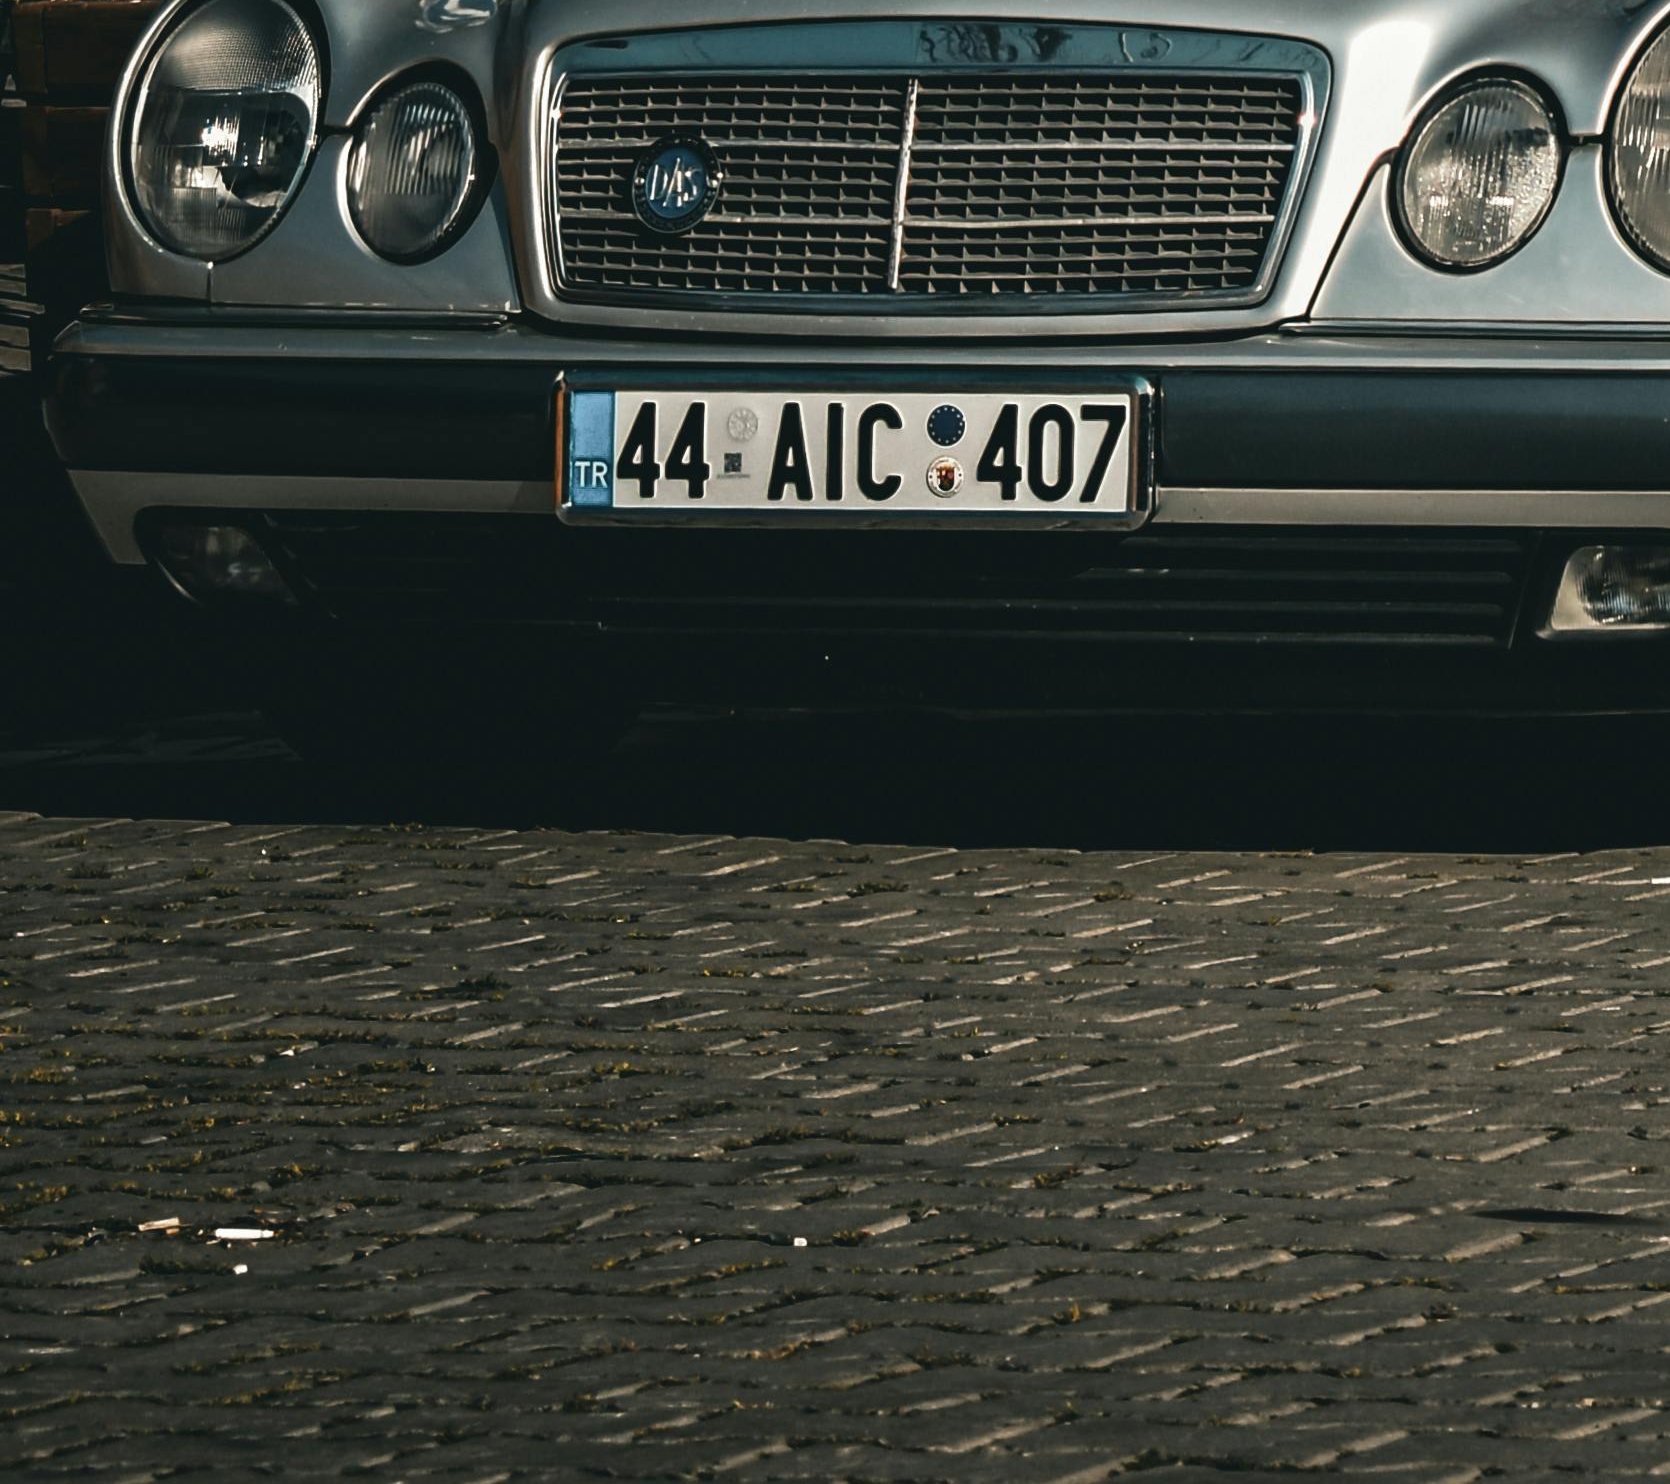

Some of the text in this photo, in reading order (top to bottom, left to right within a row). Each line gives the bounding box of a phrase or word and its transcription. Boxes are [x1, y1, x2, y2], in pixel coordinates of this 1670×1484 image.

[575, 461, 608, 489] TR
[616, 402, 710, 500] 44
[767, 402, 904, 502] AIC
[976, 404, 1127, 504] 407
